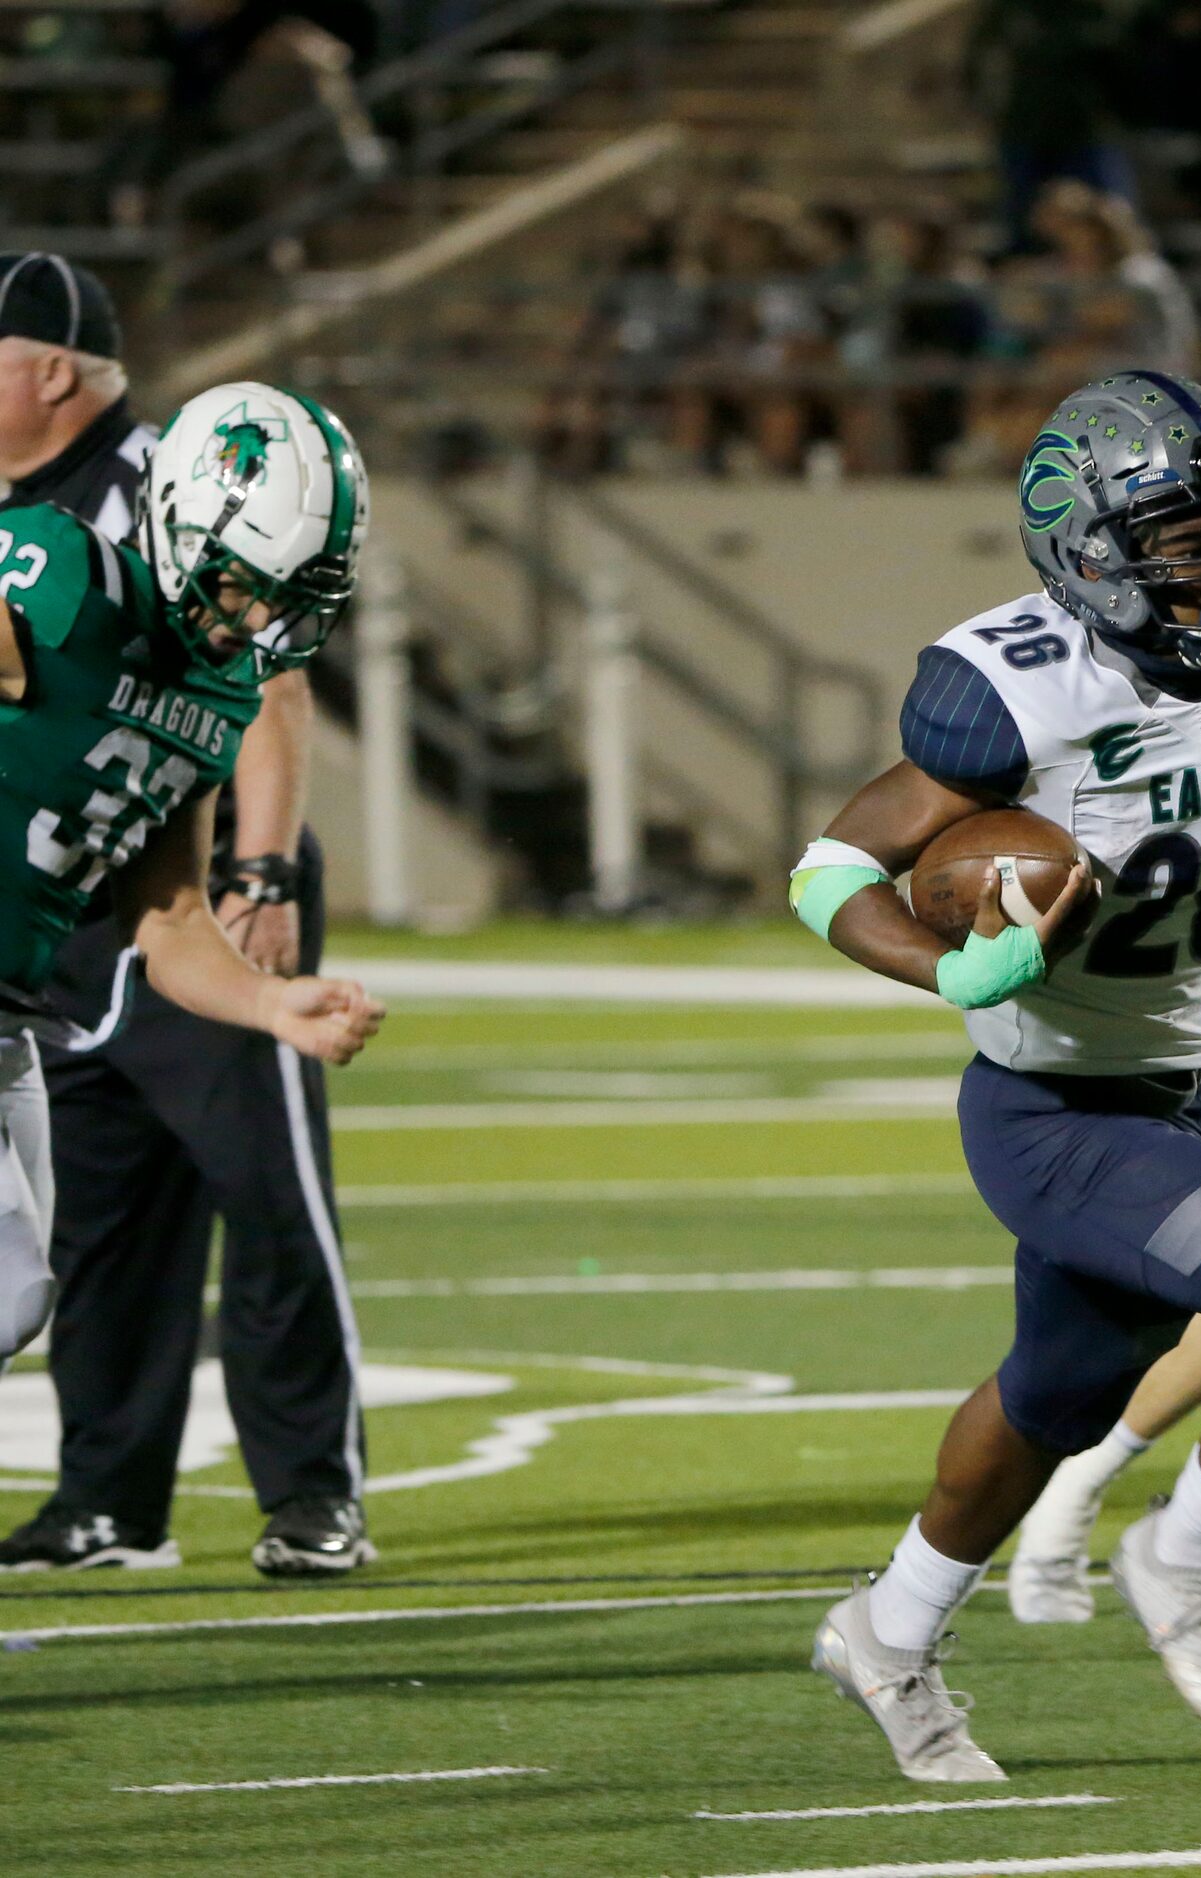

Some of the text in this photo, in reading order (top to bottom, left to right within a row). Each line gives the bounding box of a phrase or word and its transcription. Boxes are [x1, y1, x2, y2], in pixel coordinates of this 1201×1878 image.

[1138, 471, 1165, 484] schutt
[970, 614, 1071, 671] 26
[107, 673, 229, 757] DRAGONS
